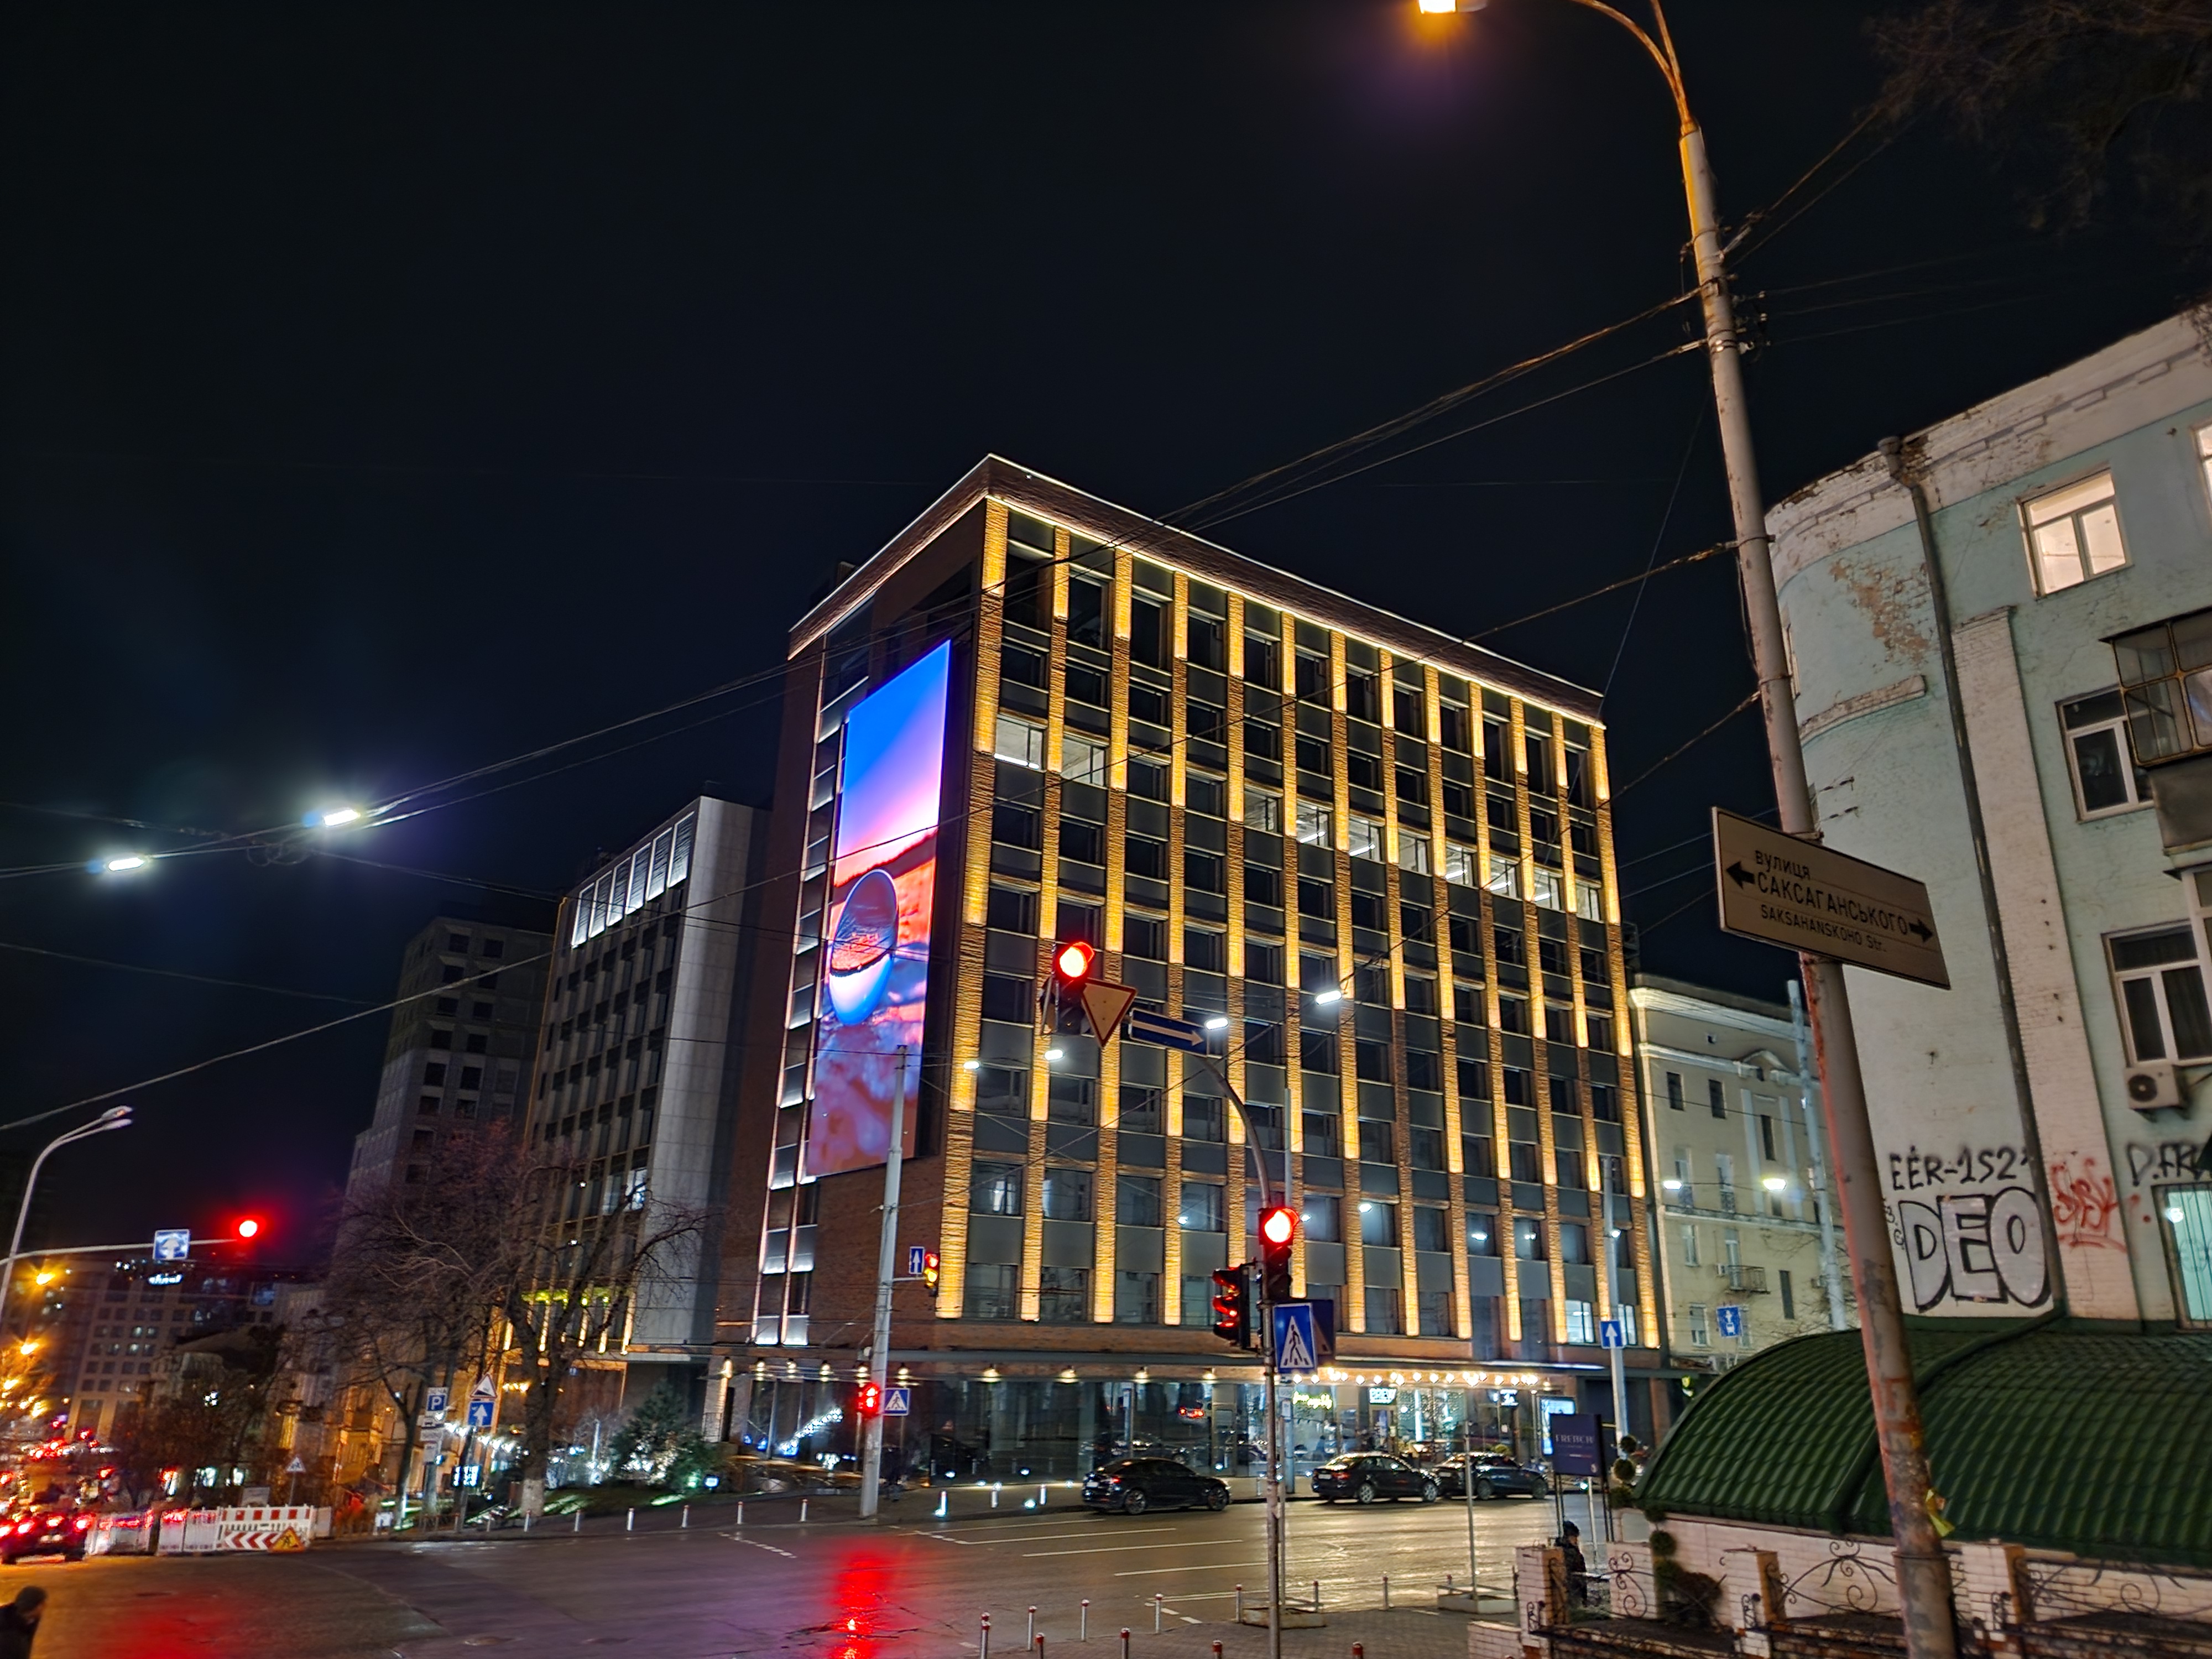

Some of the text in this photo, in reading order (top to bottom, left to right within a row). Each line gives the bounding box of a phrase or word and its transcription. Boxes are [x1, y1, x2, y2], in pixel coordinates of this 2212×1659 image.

[1757, 872, 1907, 935] САКСАГАНСЬКОГО
[1761, 905, 1861, 945] SAKSAHANSKOHO
[1898, 1186, 2051, 1313] DEO
